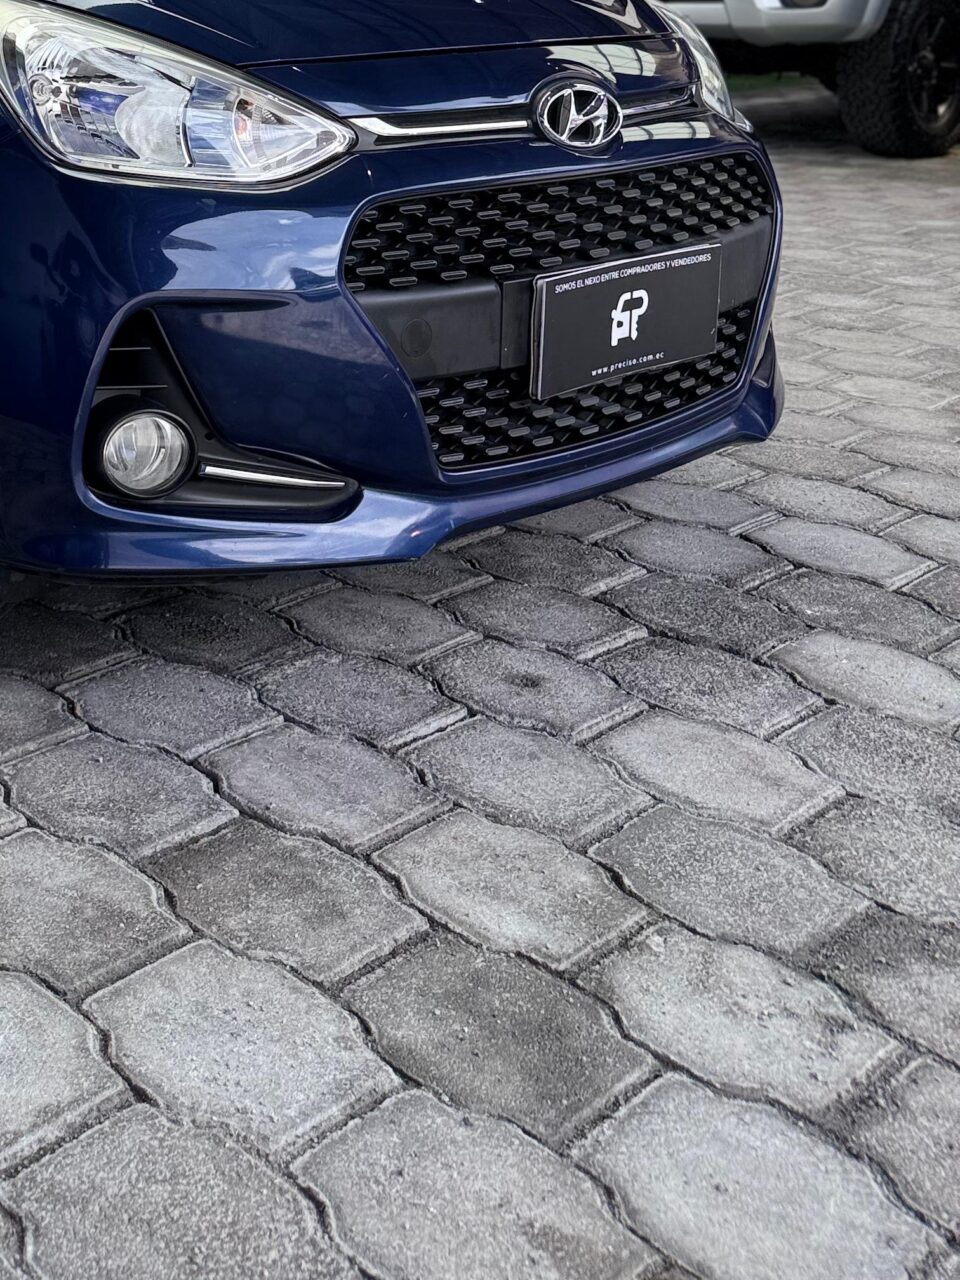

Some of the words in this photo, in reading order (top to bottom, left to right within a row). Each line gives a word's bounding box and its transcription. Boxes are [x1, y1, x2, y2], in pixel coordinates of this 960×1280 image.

[555, 282, 576, 294] SOMOS
[577, 280, 585, 288] EL
[585, 275, 601, 286] NEXO
[601, 272, 620, 283] ENTRE
[620, 261, 666, 278] COMPRADORES
[666, 260, 672, 268] Y
[672, 254, 711, 267] VENDEDORES
[591, 351, 664, 376] www.preciso.com.ec
